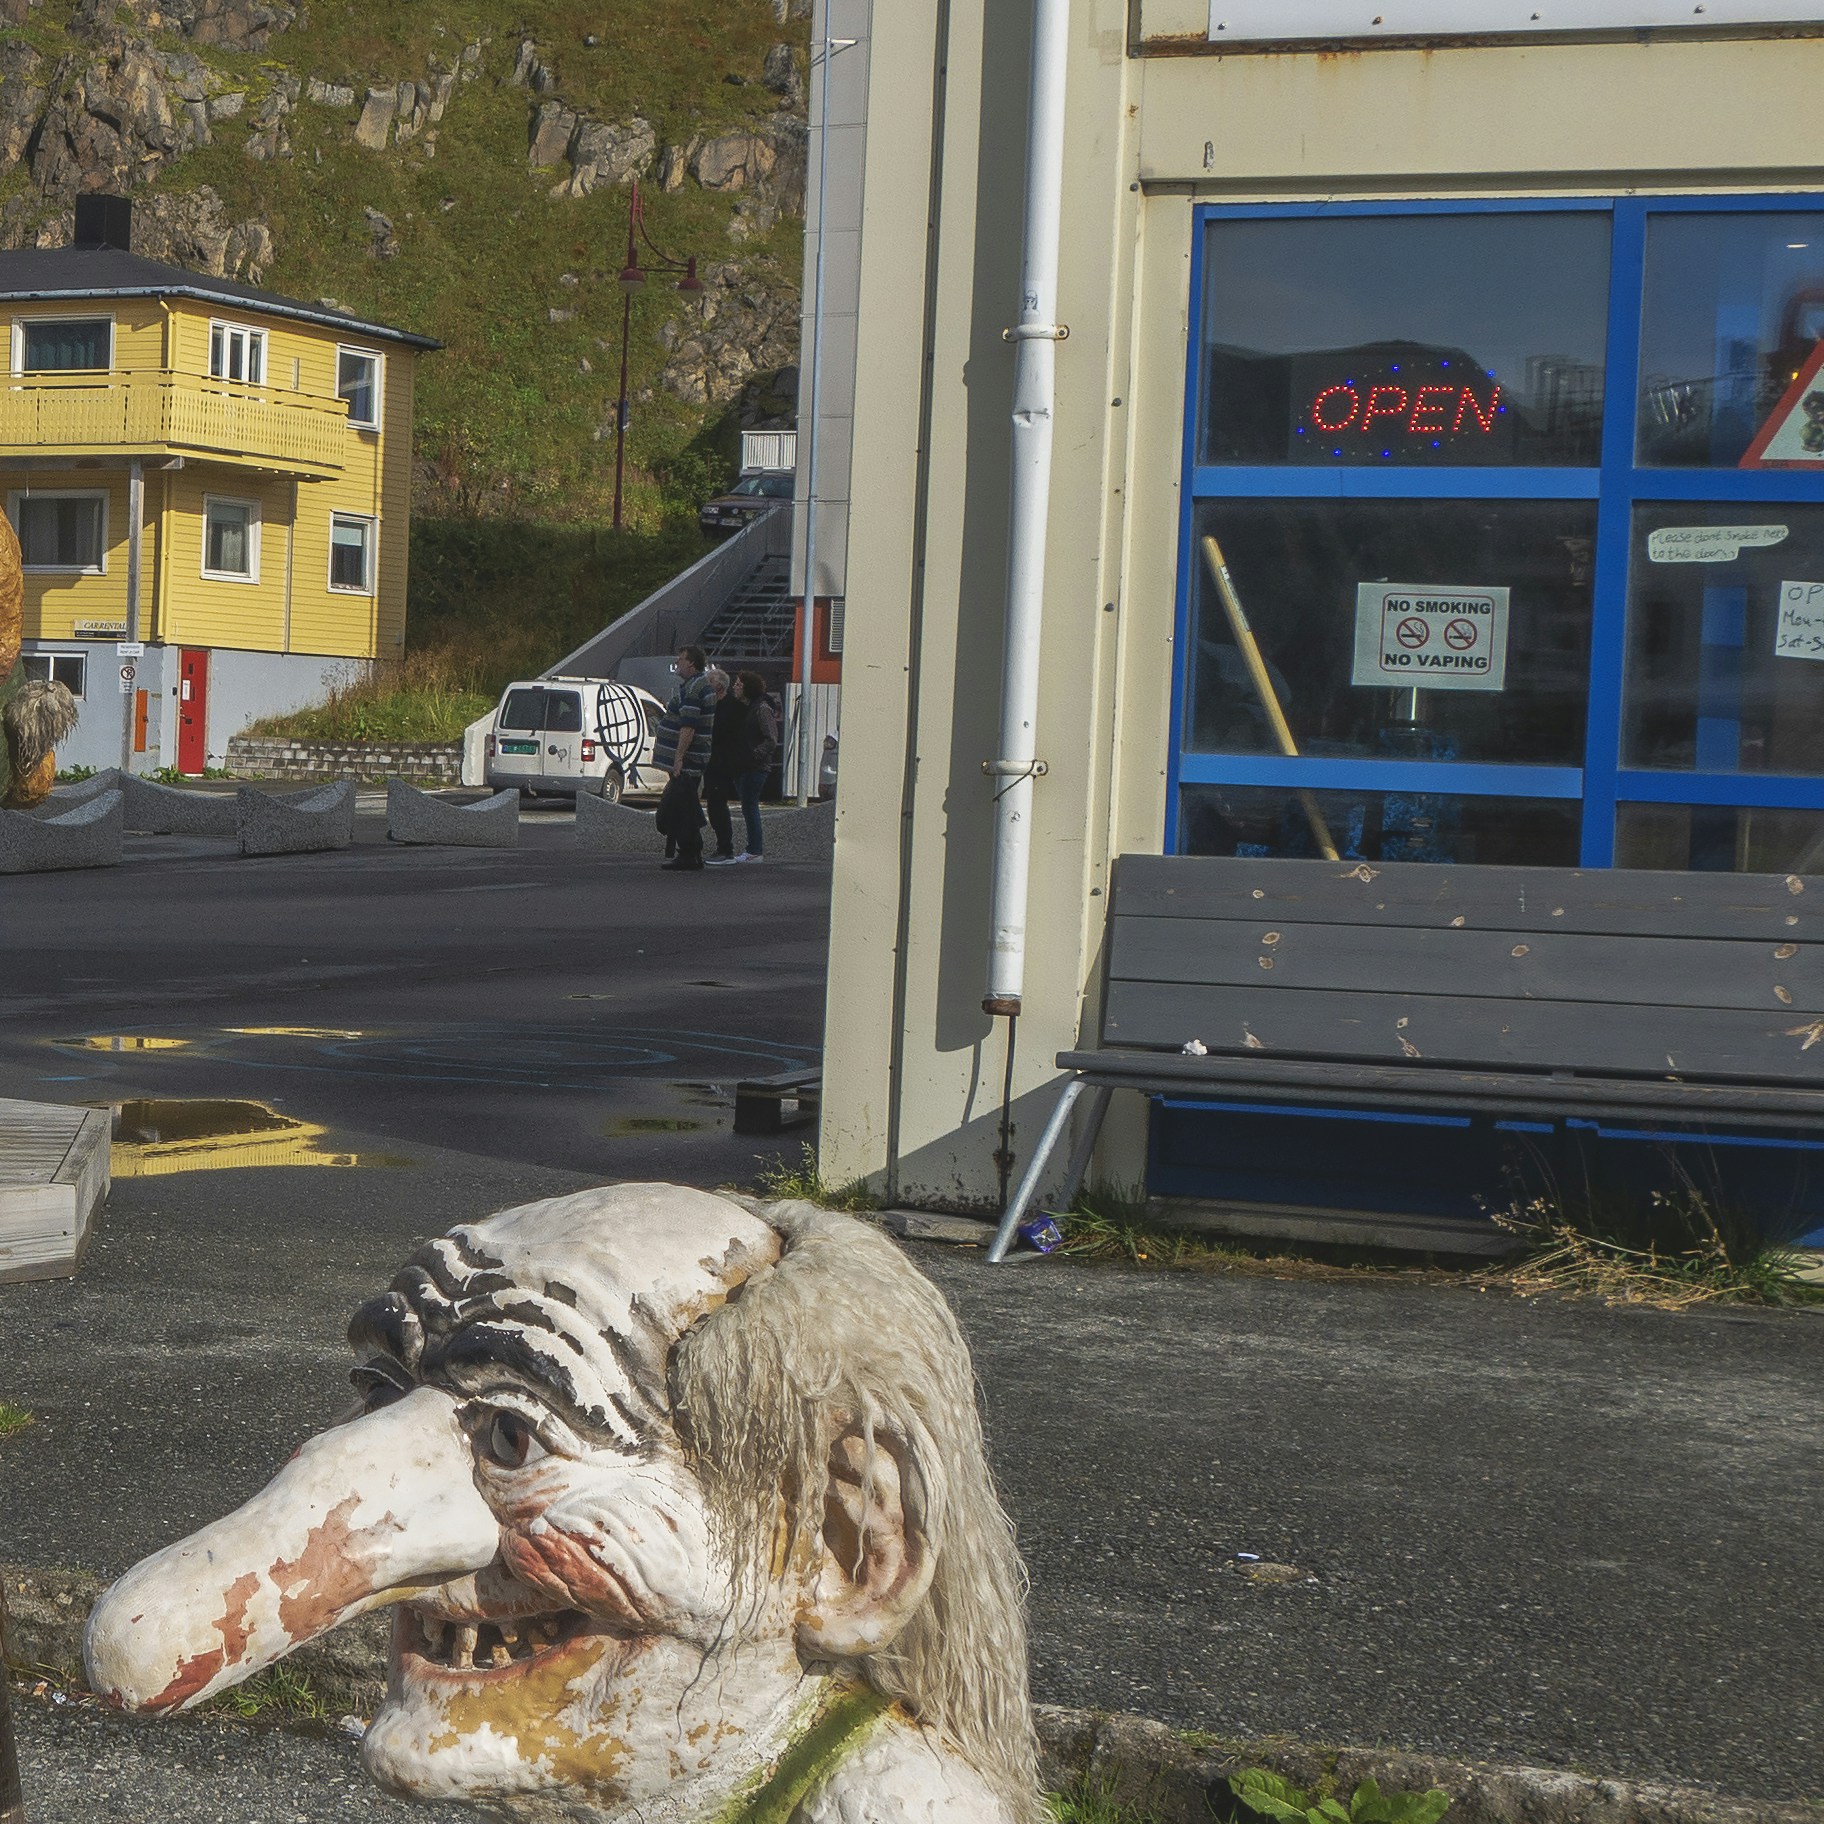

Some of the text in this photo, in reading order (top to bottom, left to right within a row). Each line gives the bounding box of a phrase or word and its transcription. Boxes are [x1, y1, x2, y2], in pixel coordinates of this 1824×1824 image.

[1313, 385, 1501, 432] OPEN
[1387, 601, 1490, 614] NO SMOKING
[1777, 634, 1824, 651] Sat-S
[1384, 653, 1488, 668] NO VAPING
